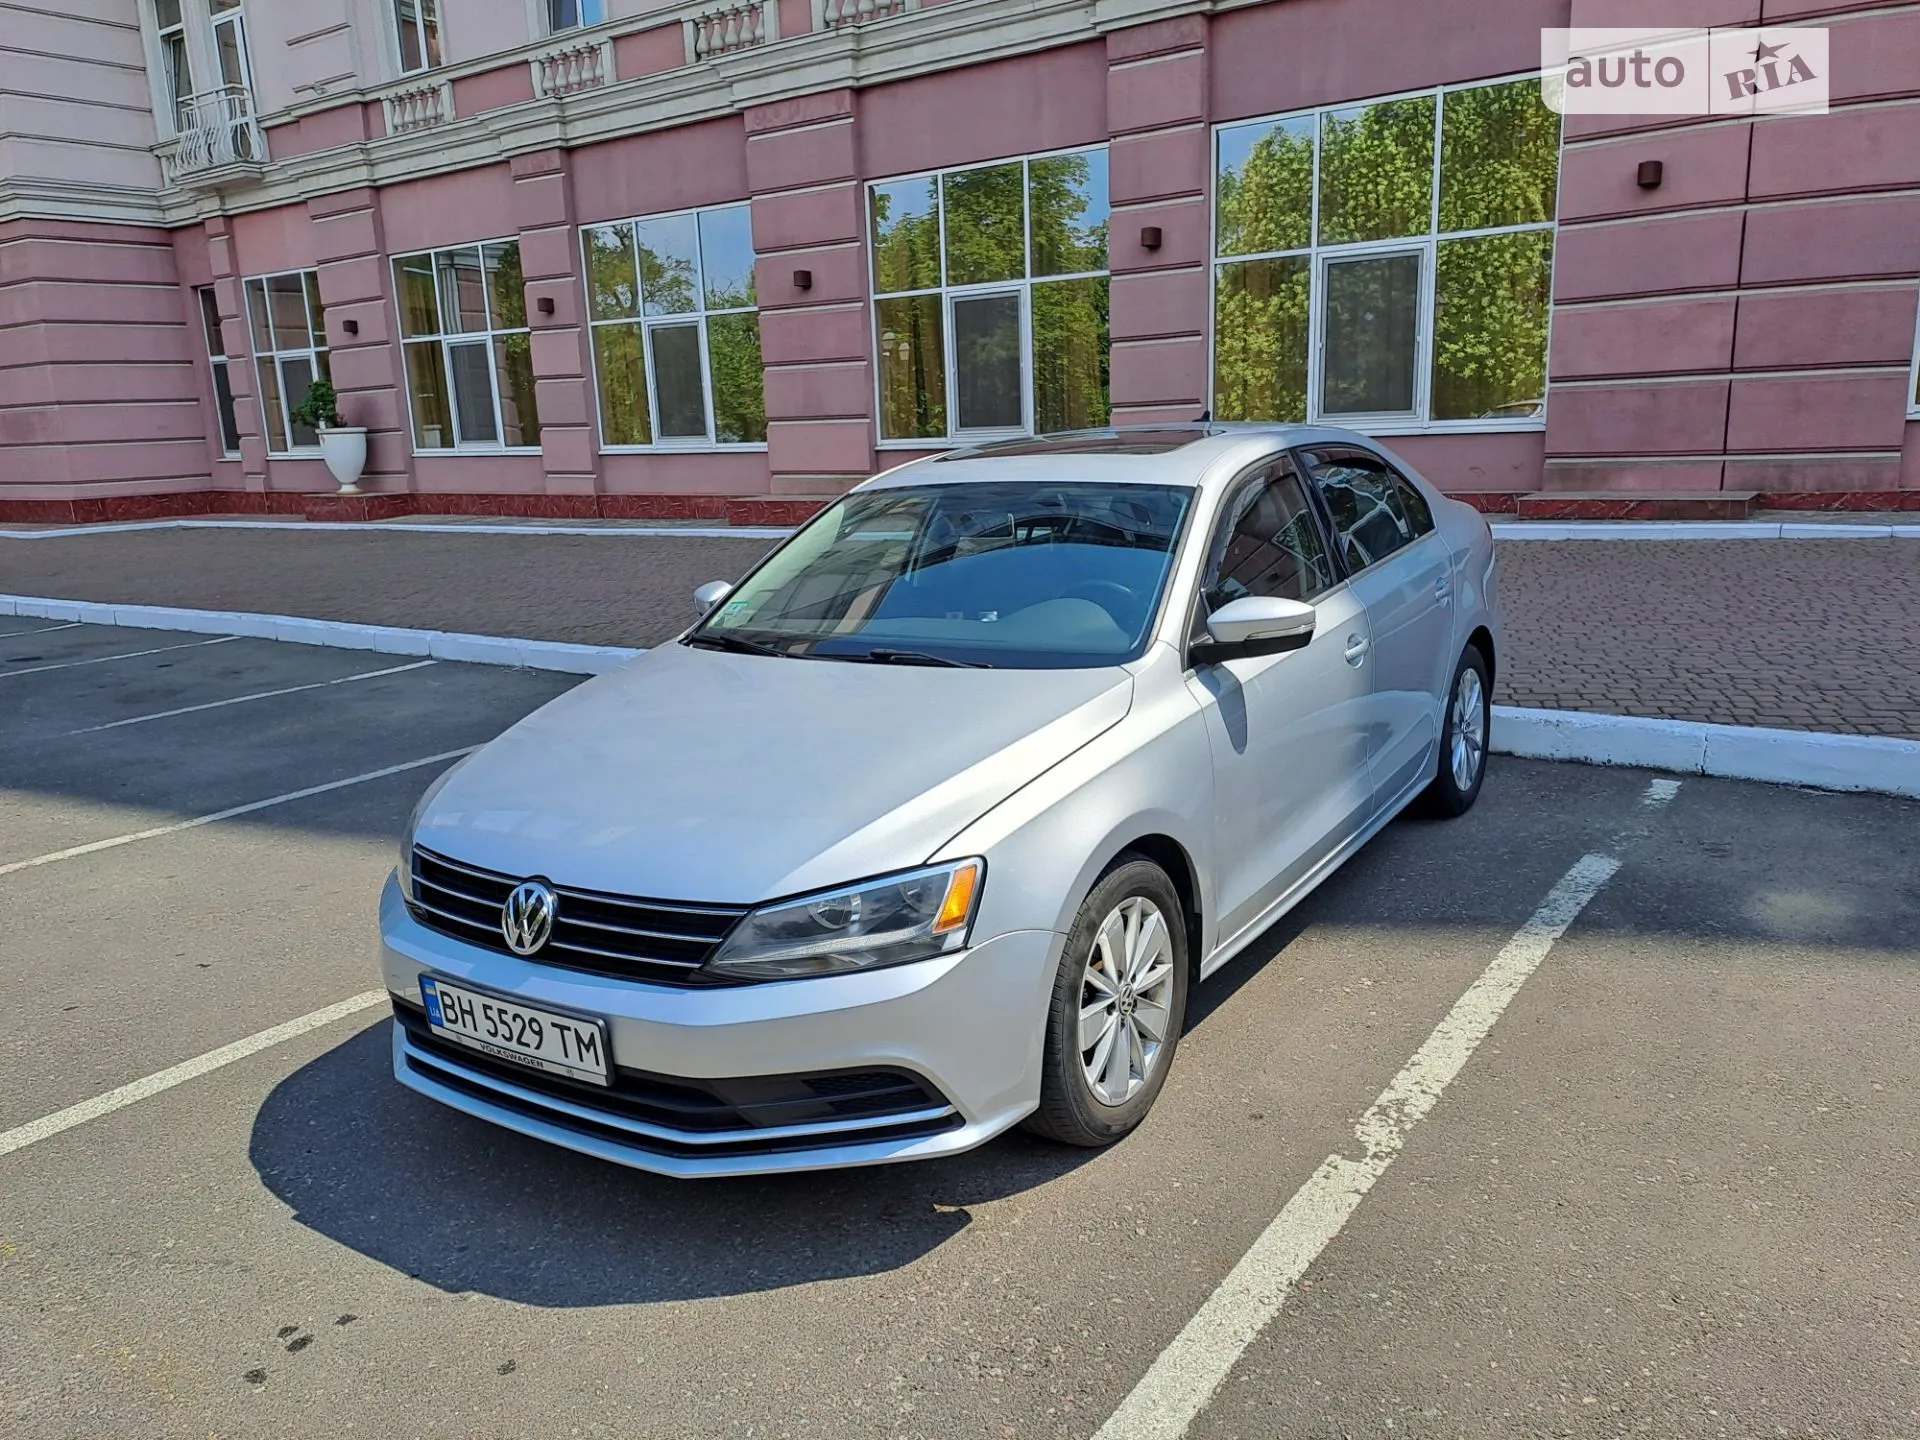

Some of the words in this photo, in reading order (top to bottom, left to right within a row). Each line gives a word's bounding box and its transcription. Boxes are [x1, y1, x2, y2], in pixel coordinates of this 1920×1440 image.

[502, 882, 553, 955] VW
[429, 1006, 440, 1019] UA
[439, 990, 478, 1032] BH
[482, 1002, 544, 1050] 5529
[550, 1022, 600, 1066] TM
[479, 1043, 544, 1068] VOLKSWAGEN
